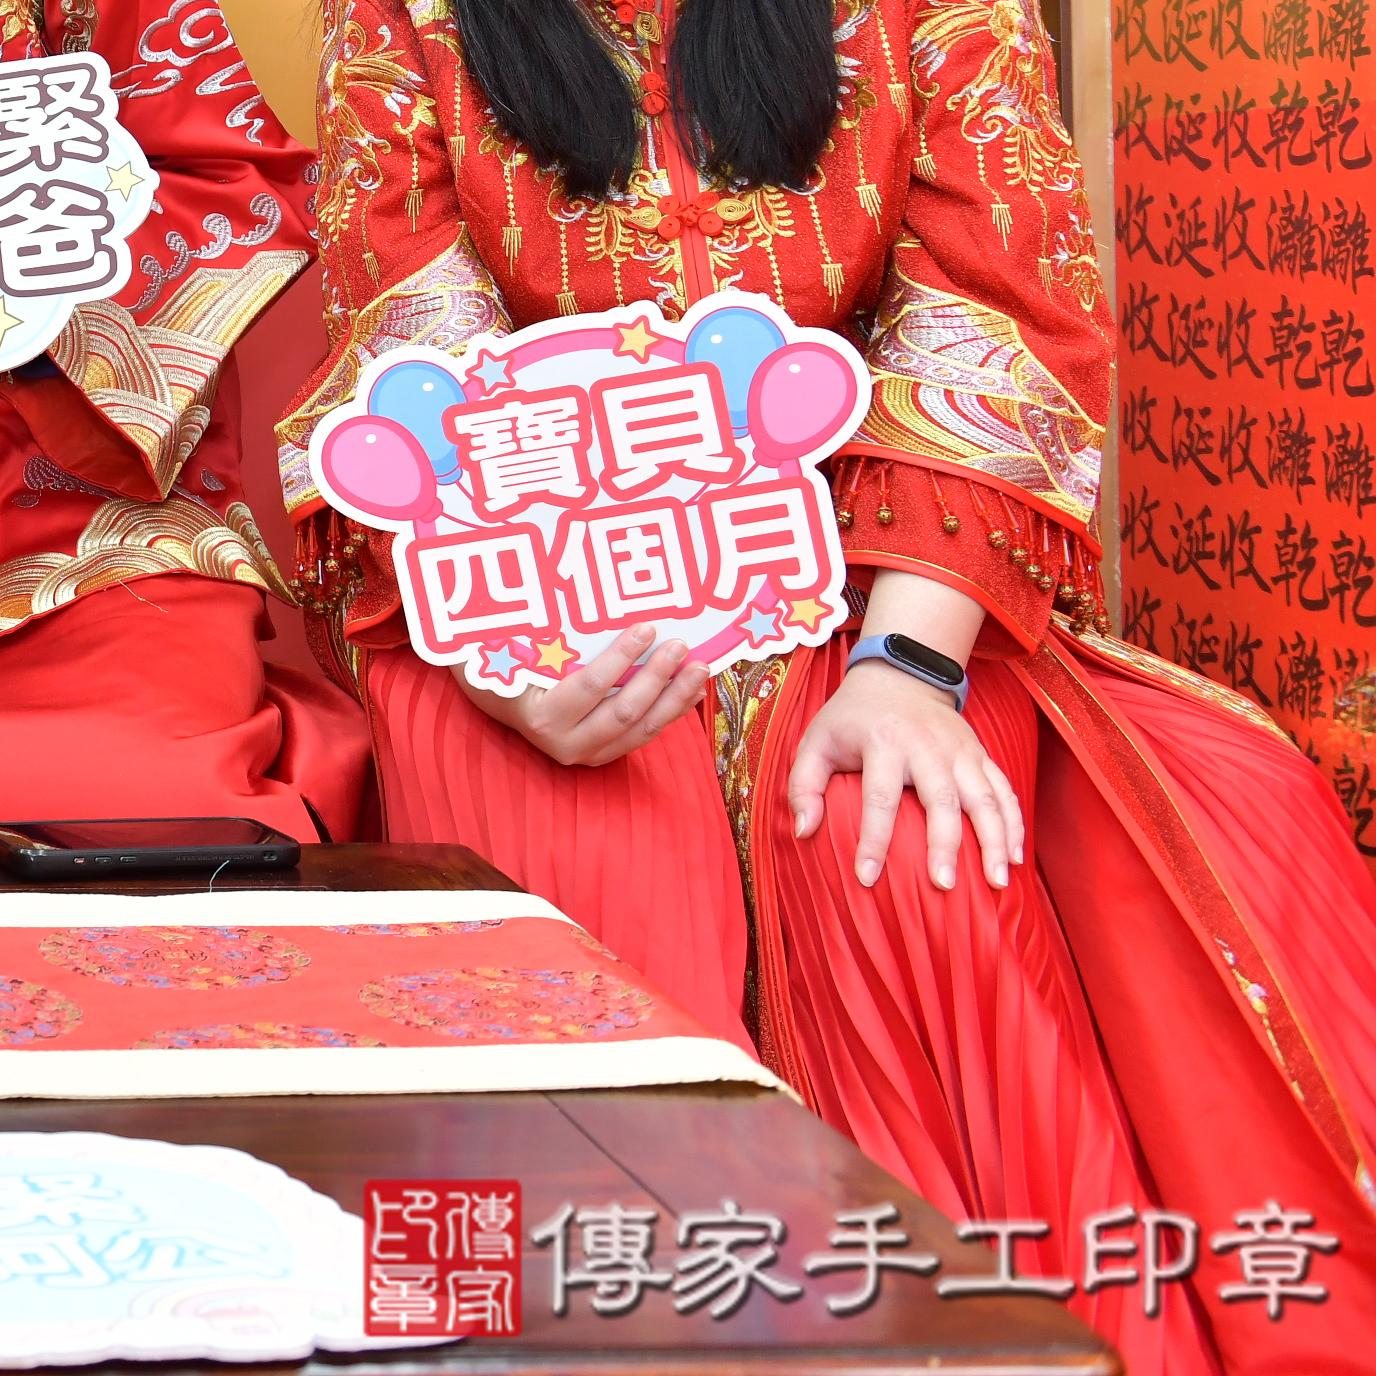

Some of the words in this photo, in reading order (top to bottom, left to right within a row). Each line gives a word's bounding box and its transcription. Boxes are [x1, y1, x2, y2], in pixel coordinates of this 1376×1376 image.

[447, 365, 739, 516] 寶貝
[411, 481, 826, 650] 四個月
